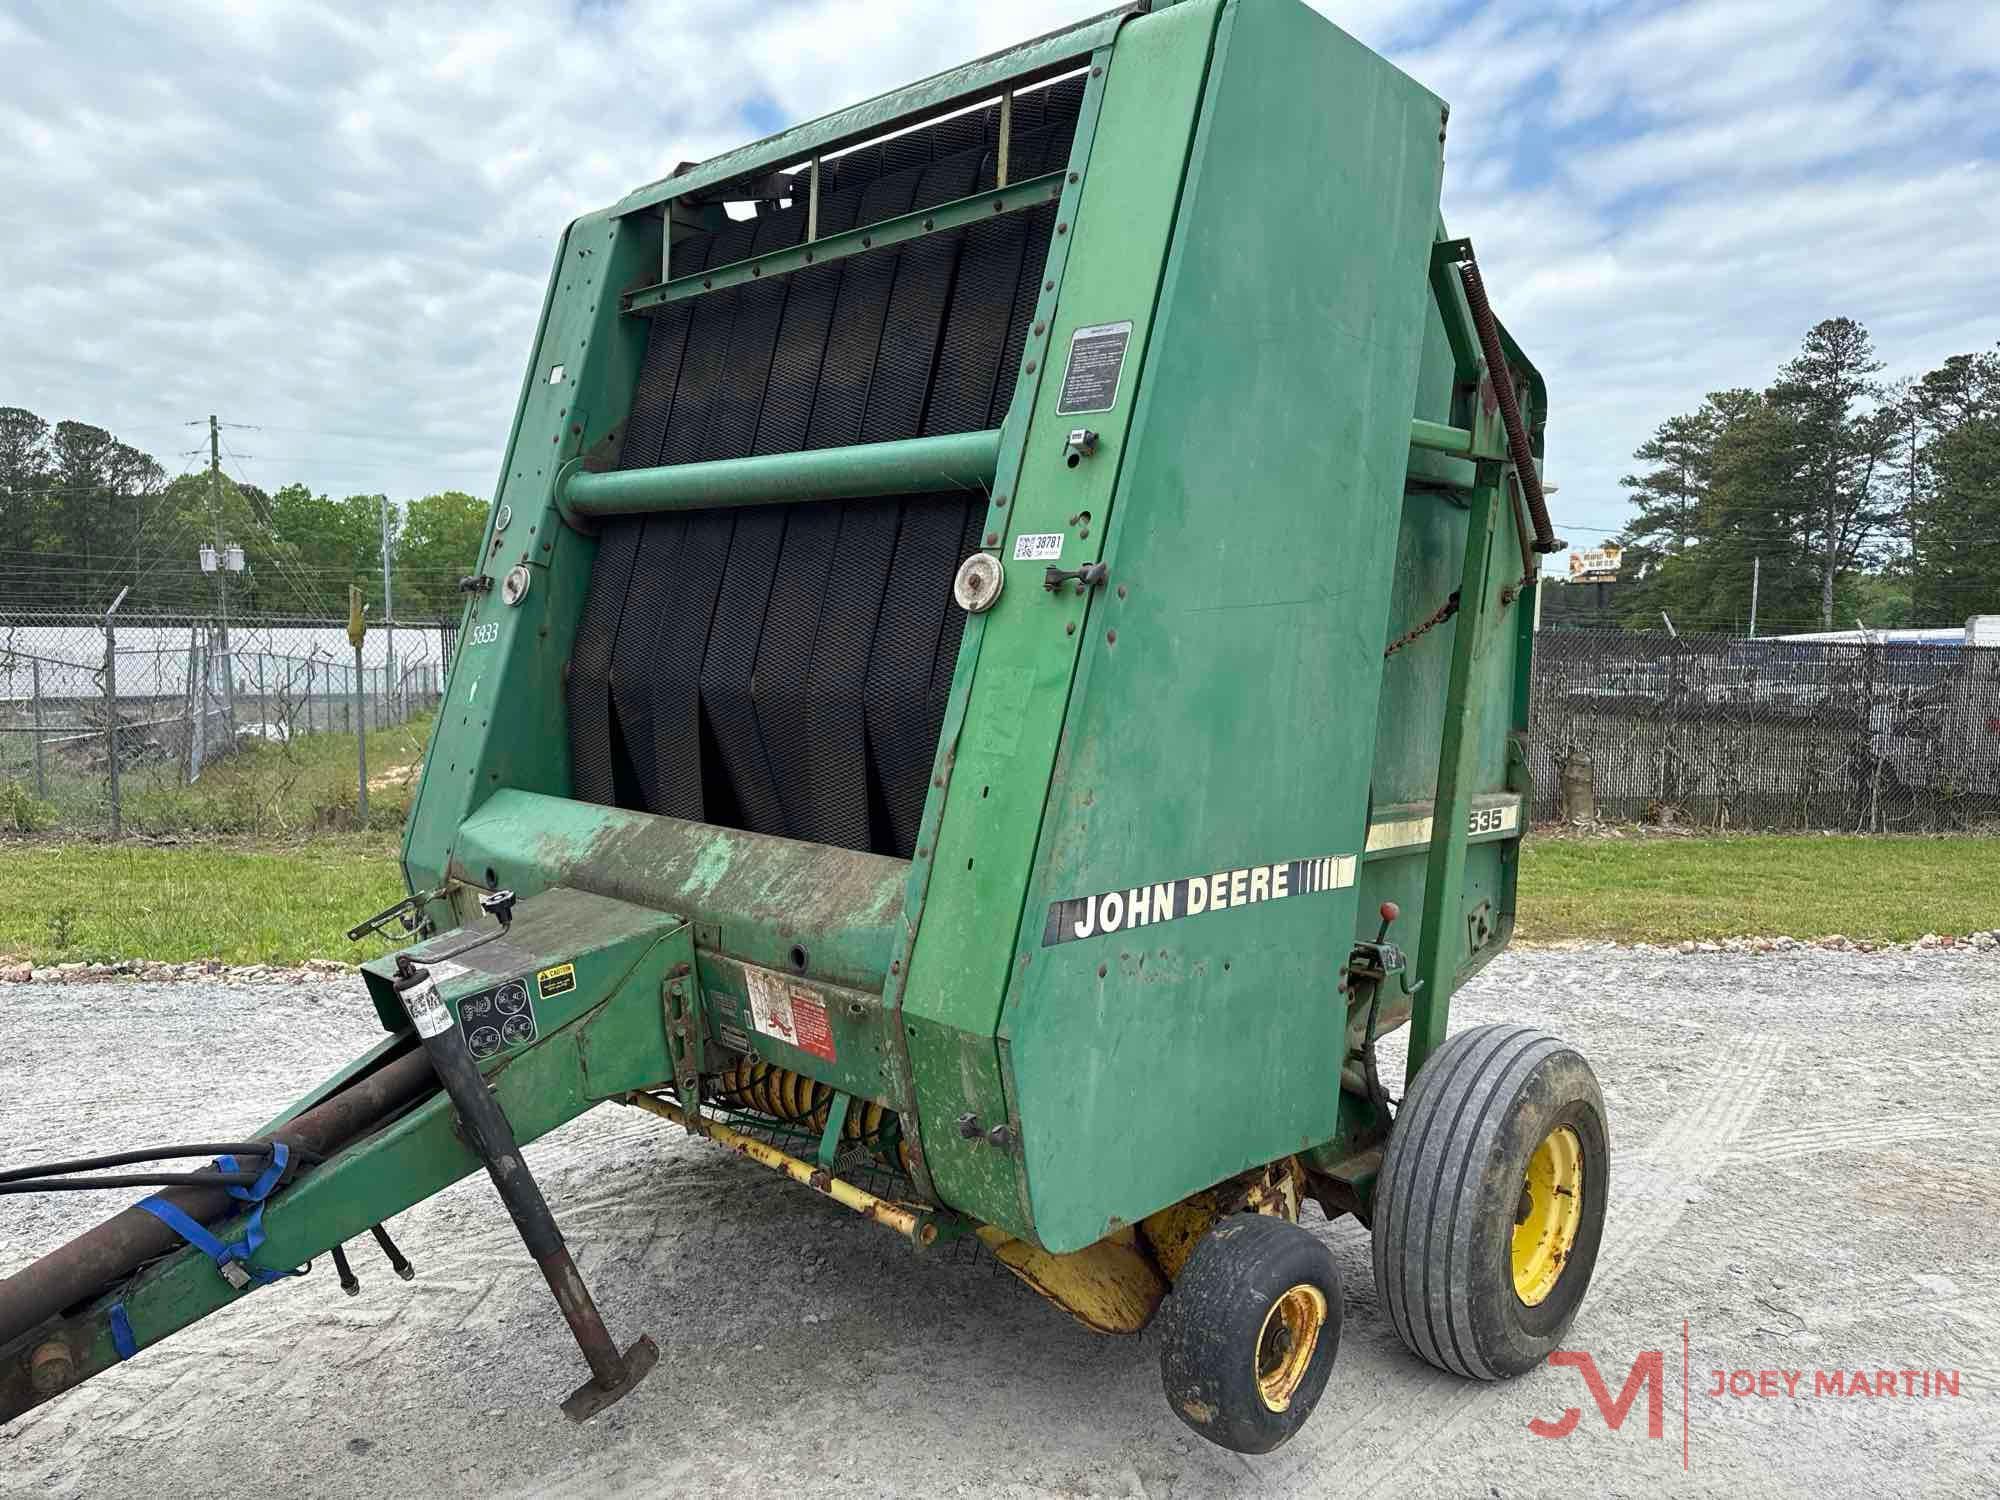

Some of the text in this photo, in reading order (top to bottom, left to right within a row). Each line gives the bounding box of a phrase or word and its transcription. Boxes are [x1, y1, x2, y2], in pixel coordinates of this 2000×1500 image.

[1036, 535, 1061, 548] 38781
[1074, 863, 1290, 938] JOHN DEERE
